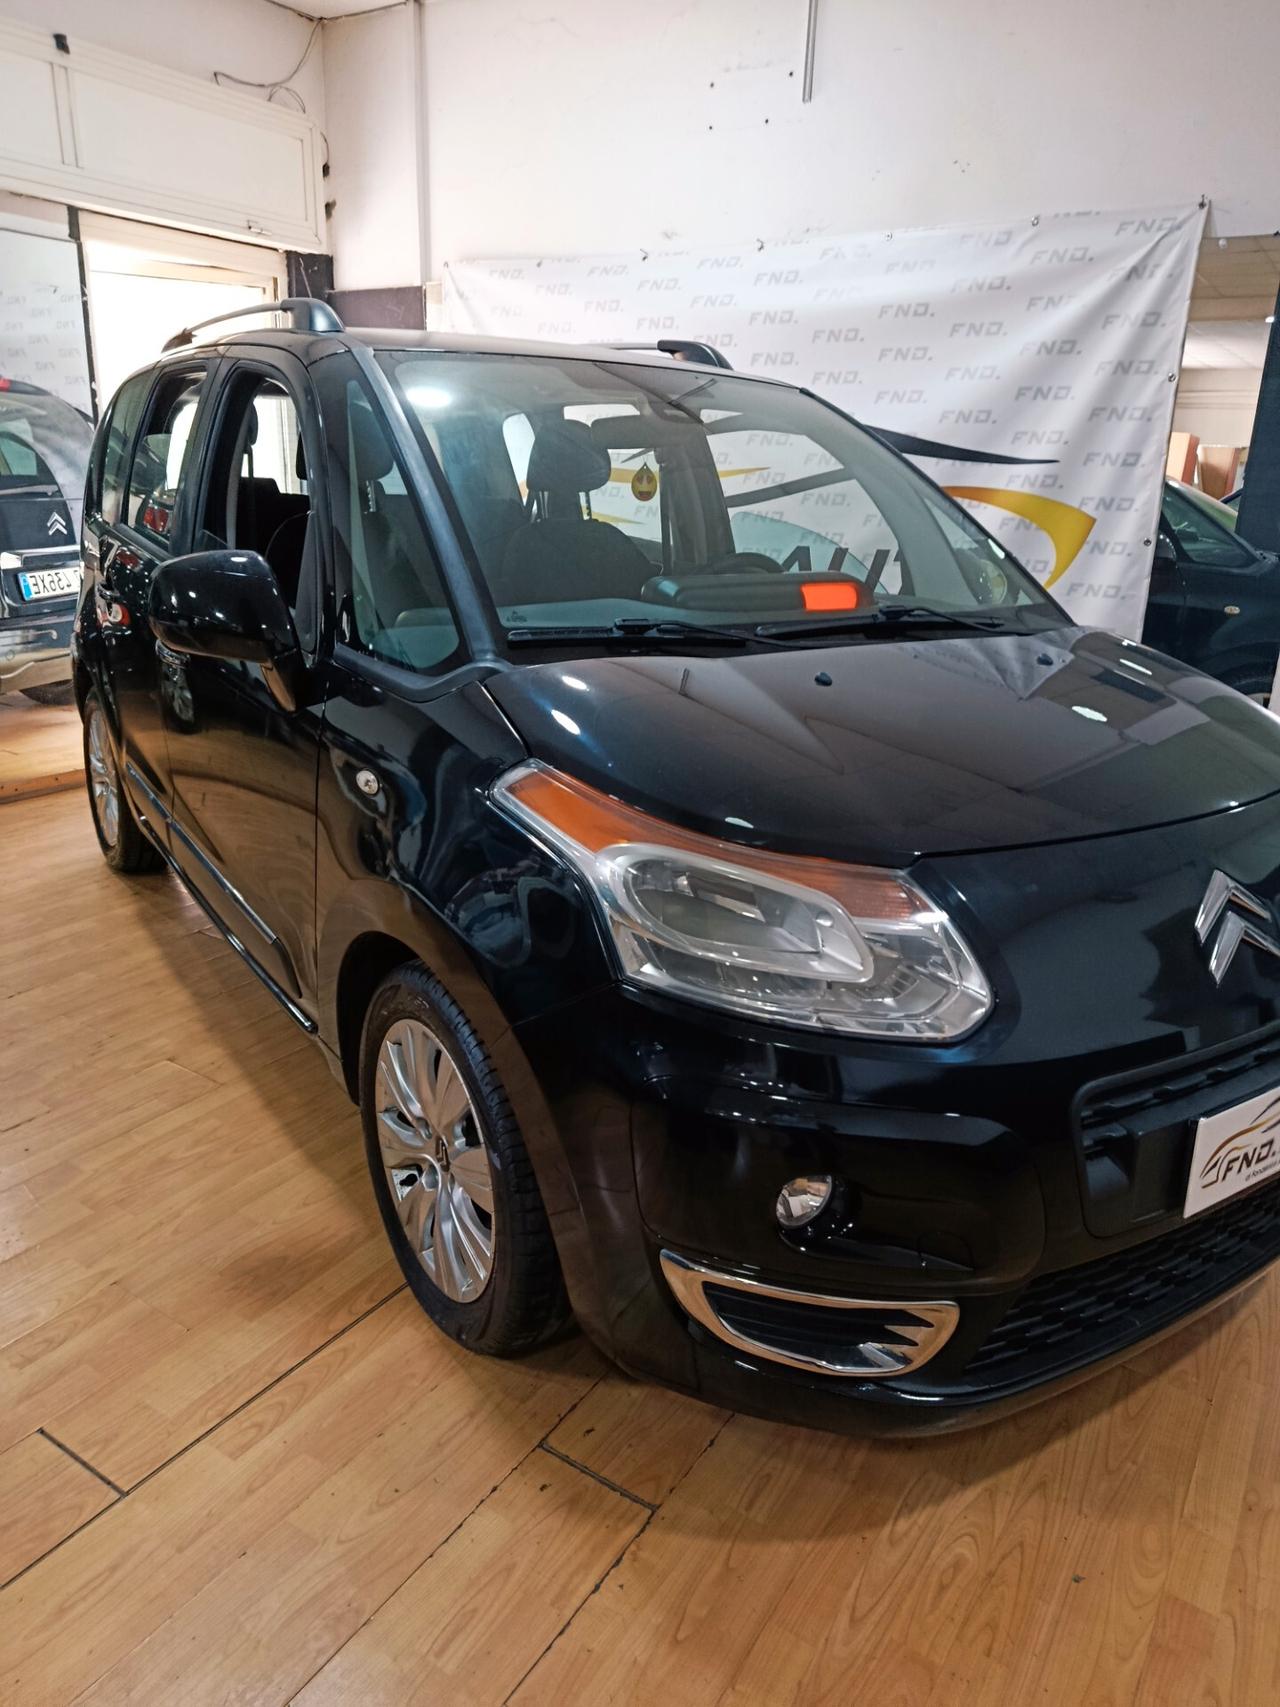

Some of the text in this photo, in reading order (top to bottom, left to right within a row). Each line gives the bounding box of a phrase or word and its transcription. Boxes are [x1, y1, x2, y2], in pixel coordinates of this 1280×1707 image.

[1030, 246, 1095, 264] FND.
[753, 270, 804, 287] FND.
[748, 310, 799, 326] FND.
[878, 302, 936, 319] FND.
[812, 328, 864, 343] FND.
[948, 322, 1008, 338] FND.
[878, 346, 934, 362] FND.
[1020, 340, 1082, 355] FND.
[750, 352, 800, 366] FND.
[945, 365, 1001, 381] FND.
[1094, 360, 1159, 376] FND.
[811, 370, 863, 385] FND.
[873, 390, 928, 404] FND.
[1015, 386, 1076, 401] FND.
[938, 409, 997, 424] FND.
[1087, 406, 1152, 423] FND.
[1011, 431, 1070, 445] FND.
[1083, 452, 1147, 468] FND.
[1006, 474, 1064, 489] FND.
[800, 493, 851, 507] FND.
[1079, 496, 1139, 512] FND.
[1066, 582, 1127, 600] FND.
[1222, 1137, 1276, 1181] FND.
